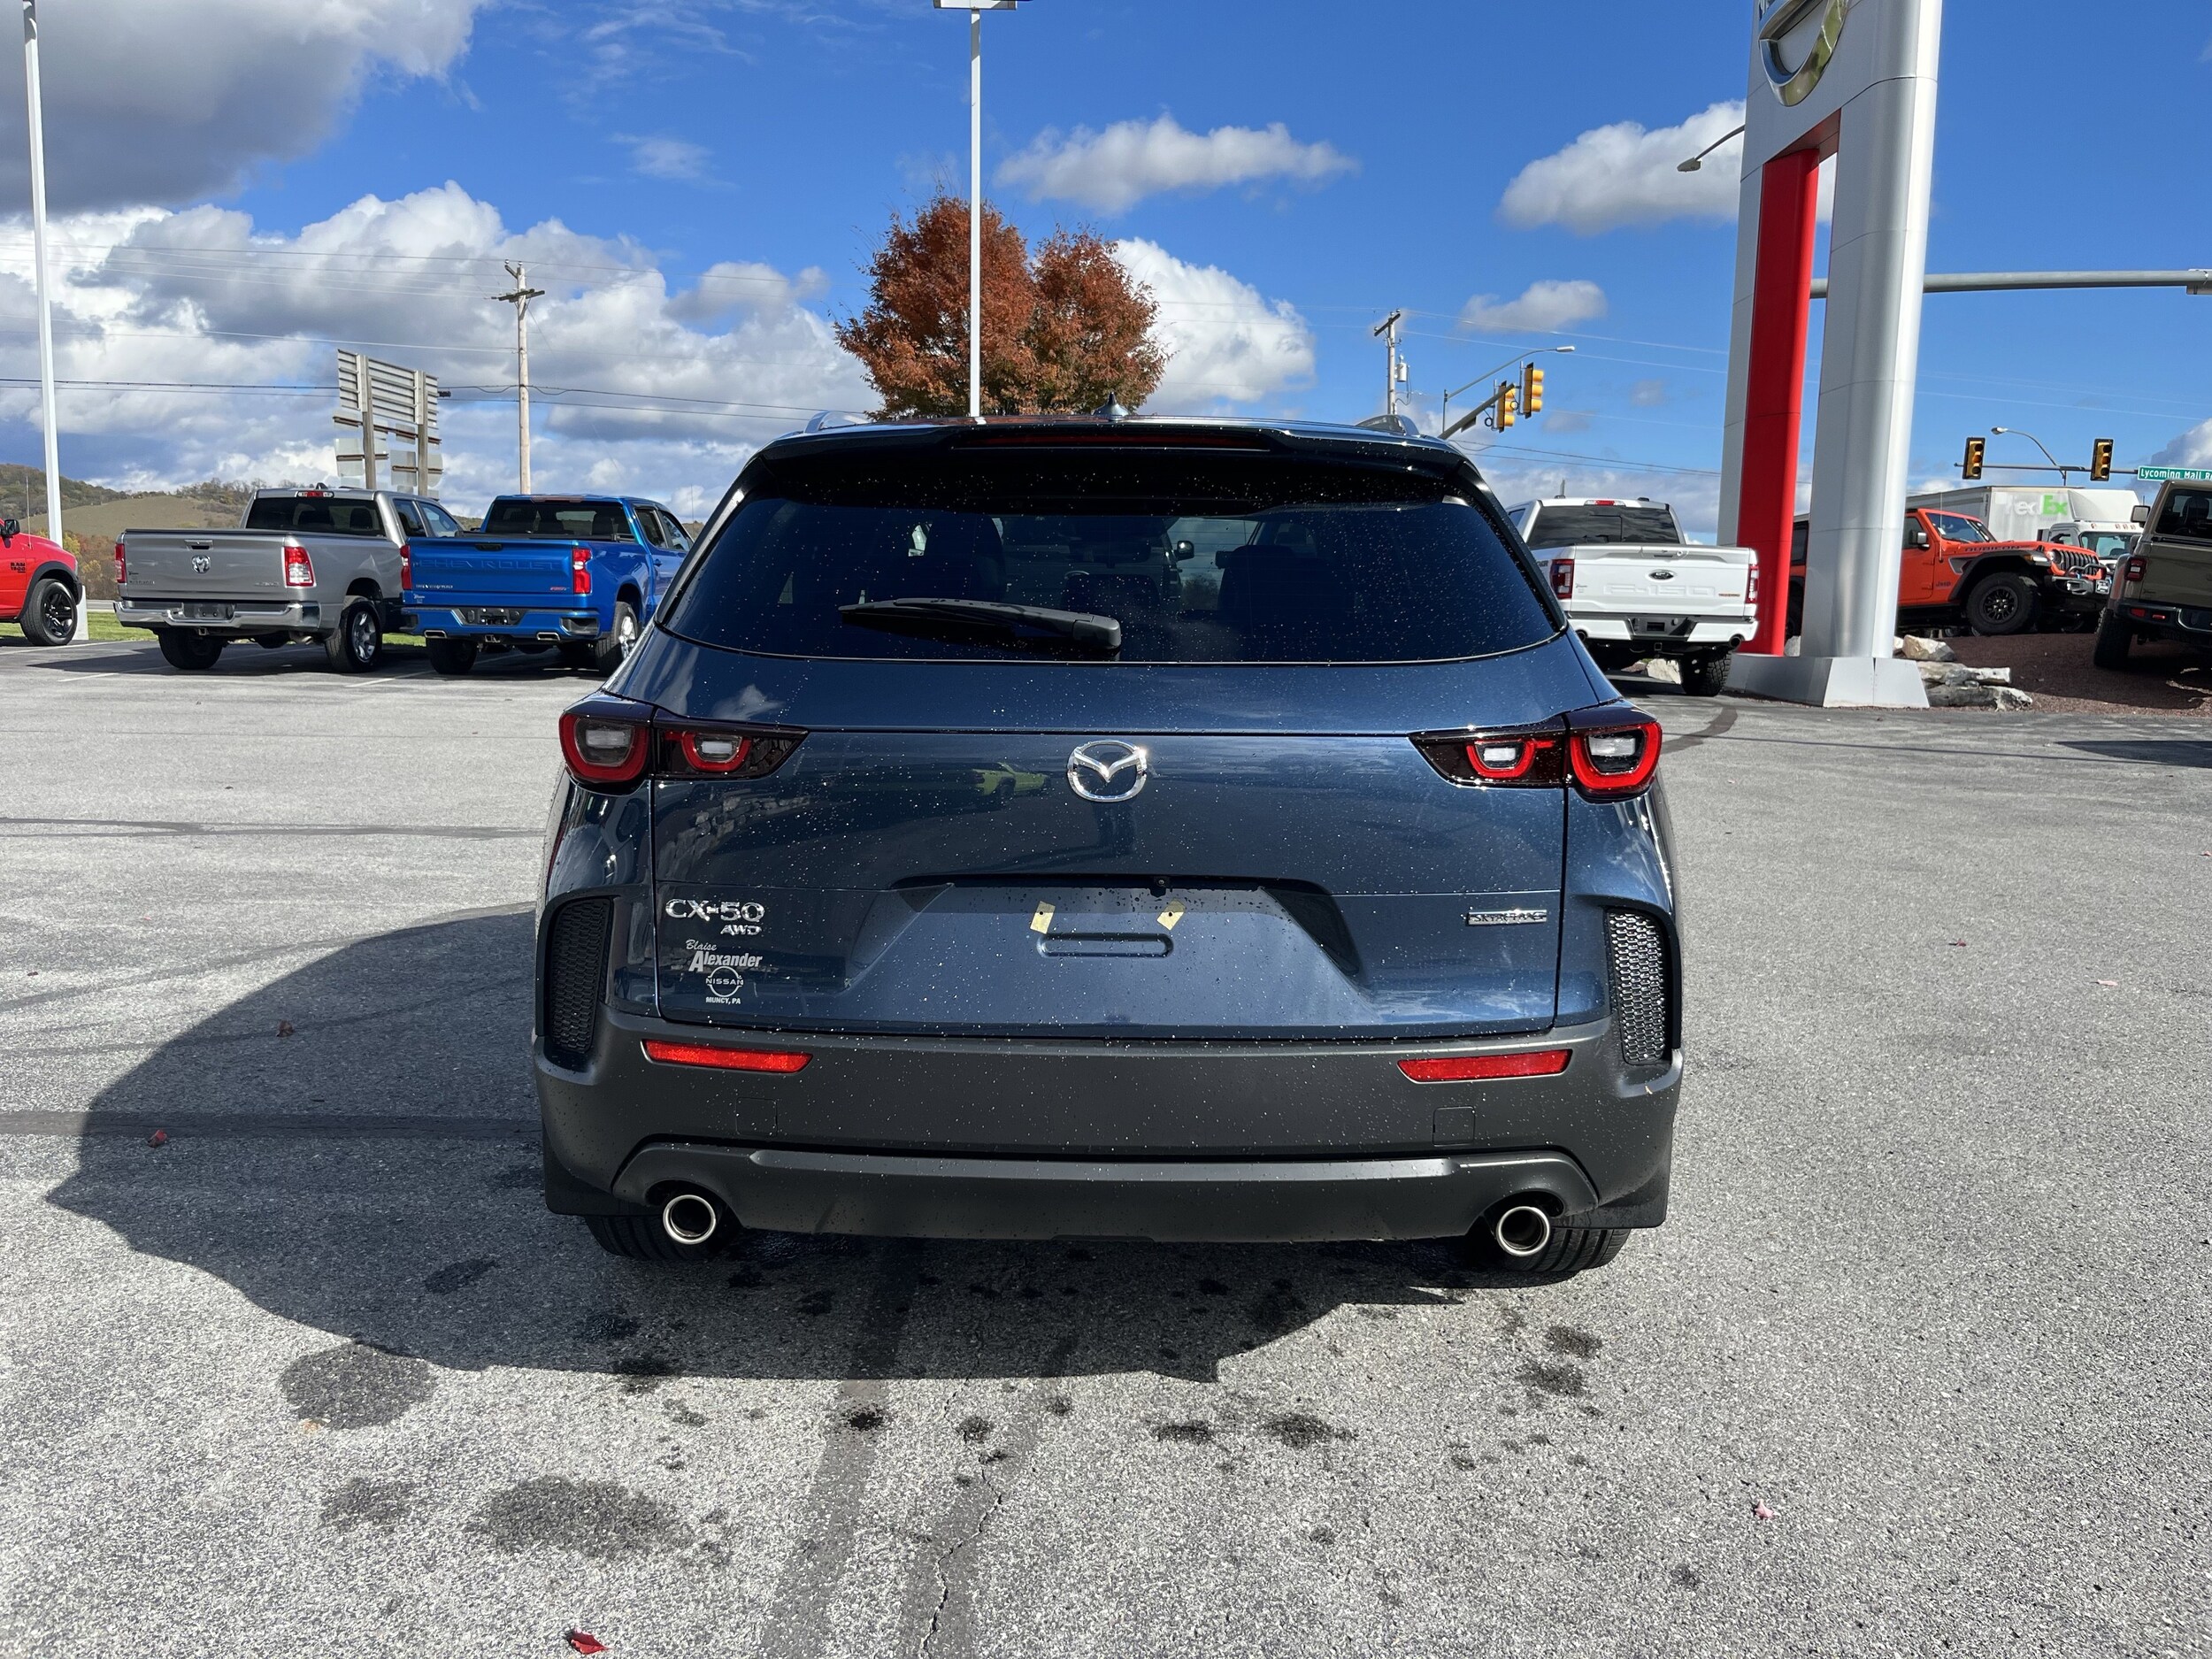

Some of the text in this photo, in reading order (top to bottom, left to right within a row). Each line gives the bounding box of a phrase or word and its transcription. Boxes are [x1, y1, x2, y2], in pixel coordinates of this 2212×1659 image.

[2140, 468, 2180, 480] Lycoming
[2184, 471, 2201, 480] Mall
[419, 558, 559, 570] CHEVROLET
[1602, 582, 1716, 597] F-150
[664, 898, 765, 923] CX-50
[719, 924, 763, 936] AWD
[686, 939, 718, 951] Blaise
[687, 950, 764, 972] Alexander
[705, 977, 744, 986] NISSAN
[705, 996, 731, 1005] MUNCY,
